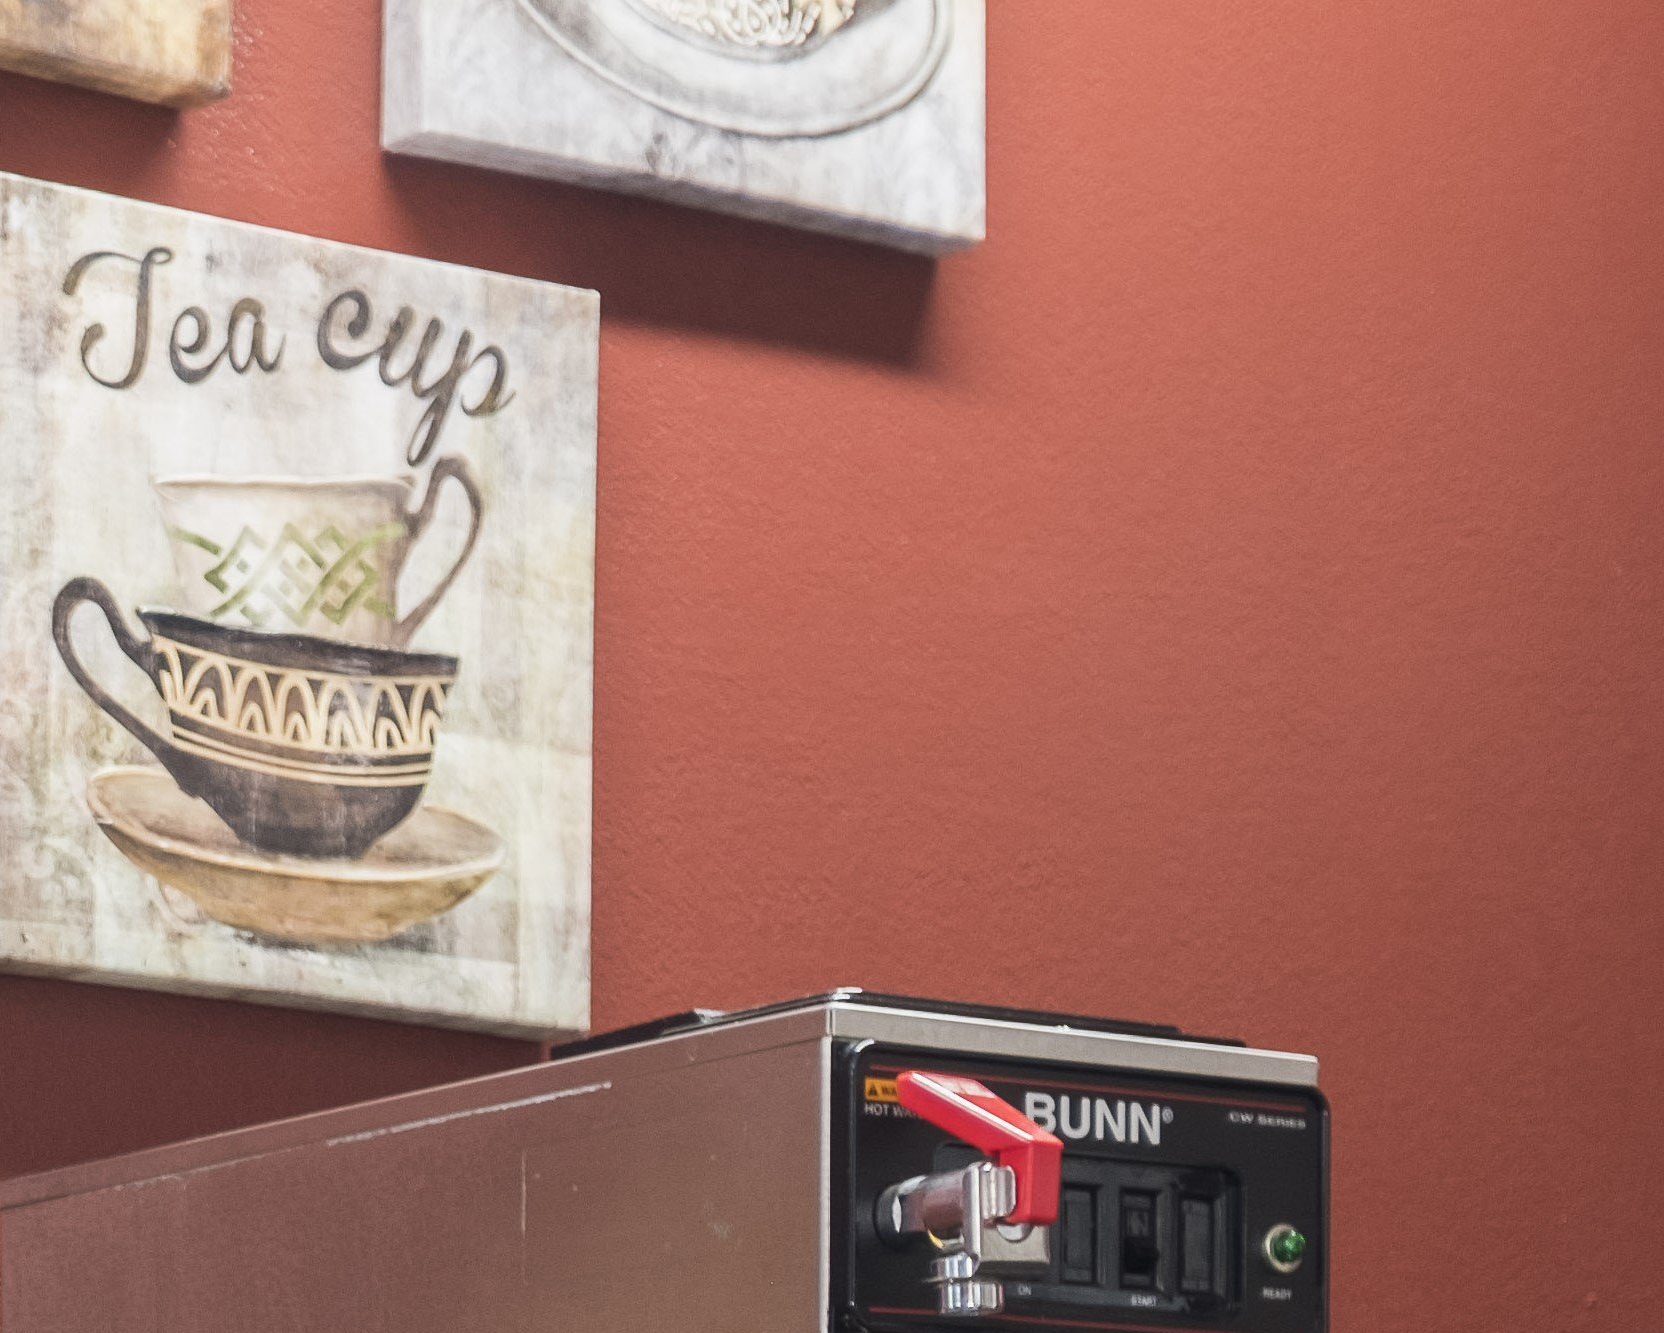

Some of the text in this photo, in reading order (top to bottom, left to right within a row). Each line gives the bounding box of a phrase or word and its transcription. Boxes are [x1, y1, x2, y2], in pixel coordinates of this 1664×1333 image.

[63, 247, 517, 465] Tea cup
[1025, 1092, 1161, 1146] BUNN
